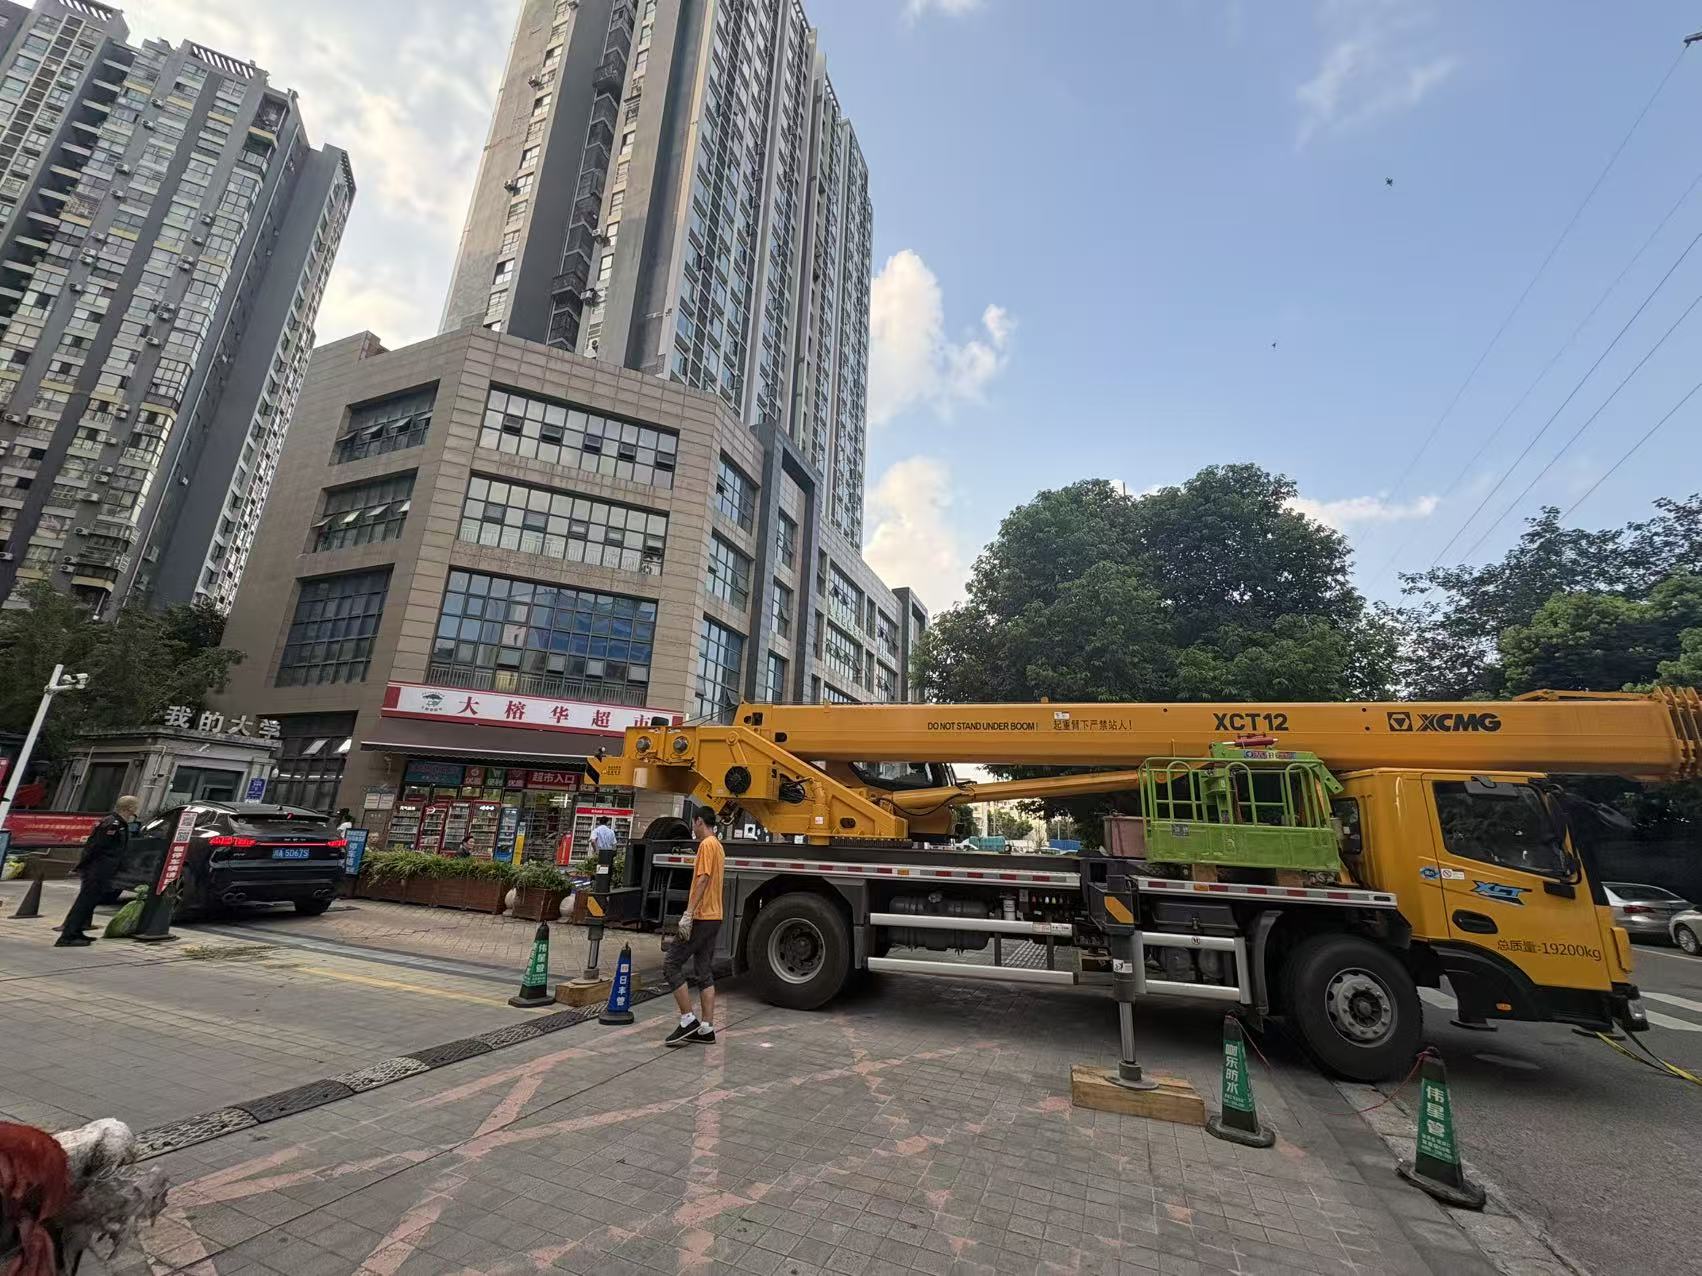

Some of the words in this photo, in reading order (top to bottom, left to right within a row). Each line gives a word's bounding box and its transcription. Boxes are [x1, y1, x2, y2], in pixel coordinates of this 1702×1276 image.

[164, 705, 281, 739] 我的大学
[927, 721, 939, 731] DO
[940, 721, 955, 731] NOT
[956, 721, 982, 731] STAND
[983, 721, 1010, 731] UNDER
[1213, 712, 1289, 731] XCT12
[1416, 712, 1502, 732] XCMG
[532, 772, 576, 784] 超市入口
[1426, 1085, 1445, 1138] 伟星管
